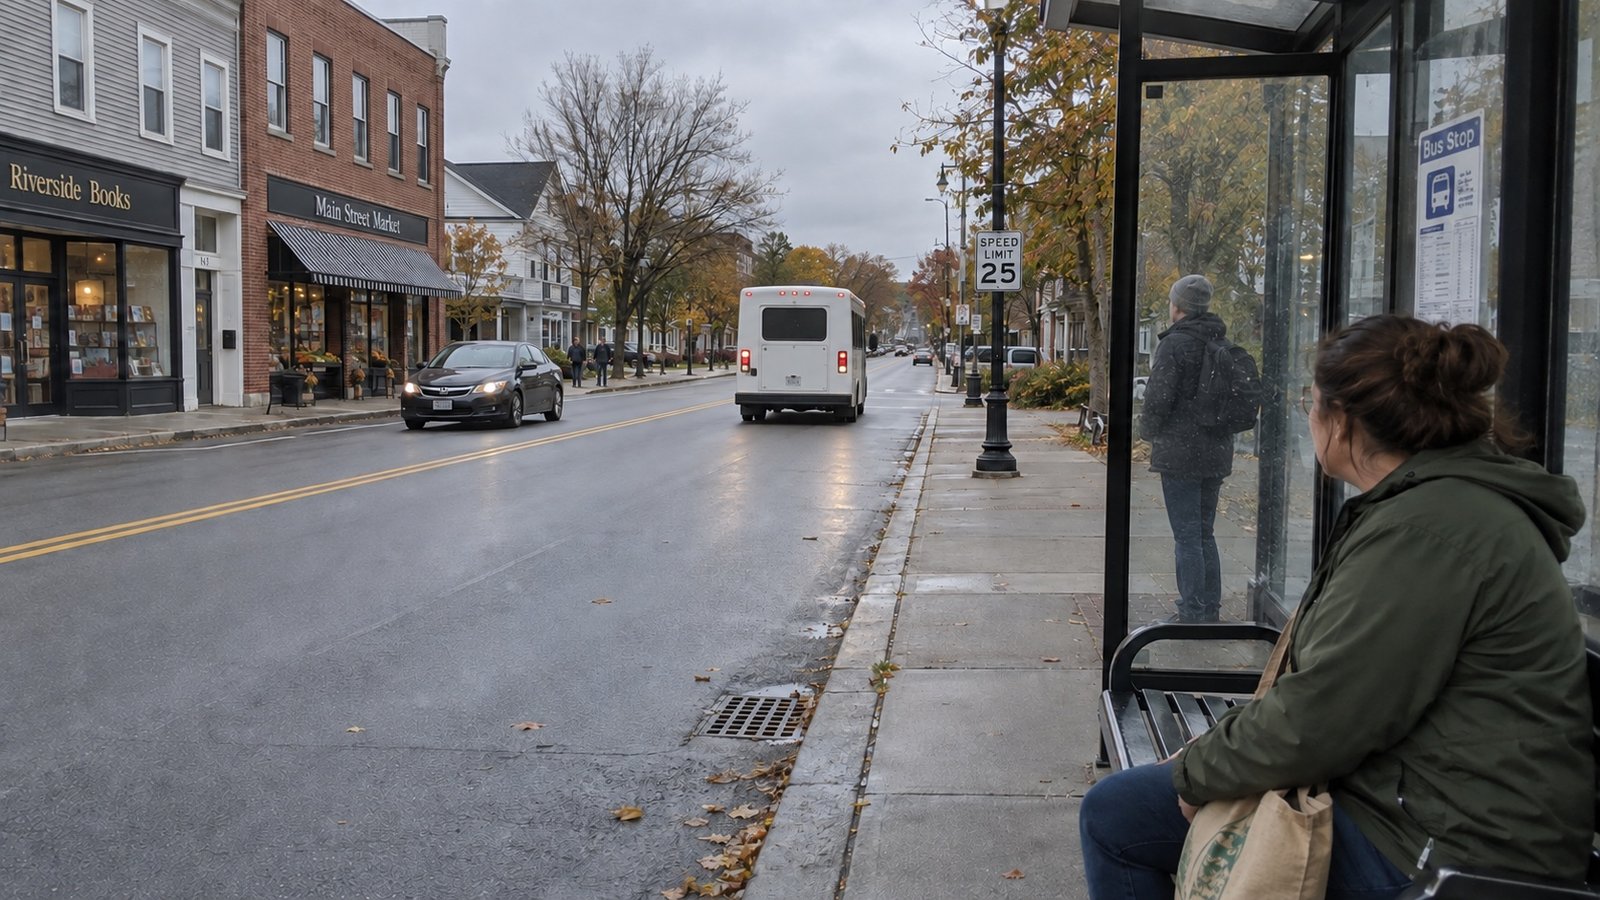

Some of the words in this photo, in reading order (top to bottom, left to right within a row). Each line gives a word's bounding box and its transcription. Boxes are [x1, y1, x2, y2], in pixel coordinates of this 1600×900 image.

[1423, 140, 1444, 159] Bus
[1446, 128, 1475, 151] Stop
[9, 162, 82, 201] Riverside
[89, 180, 131, 210] Books
[315, 195, 342, 221] Main
[344, 203, 371, 228] Street
[373, 210, 401, 234] Market
[980, 237, 1019, 247] SPEED
[984, 250, 1014, 259] LIMIT
[981, 262, 1016, 284] 25
